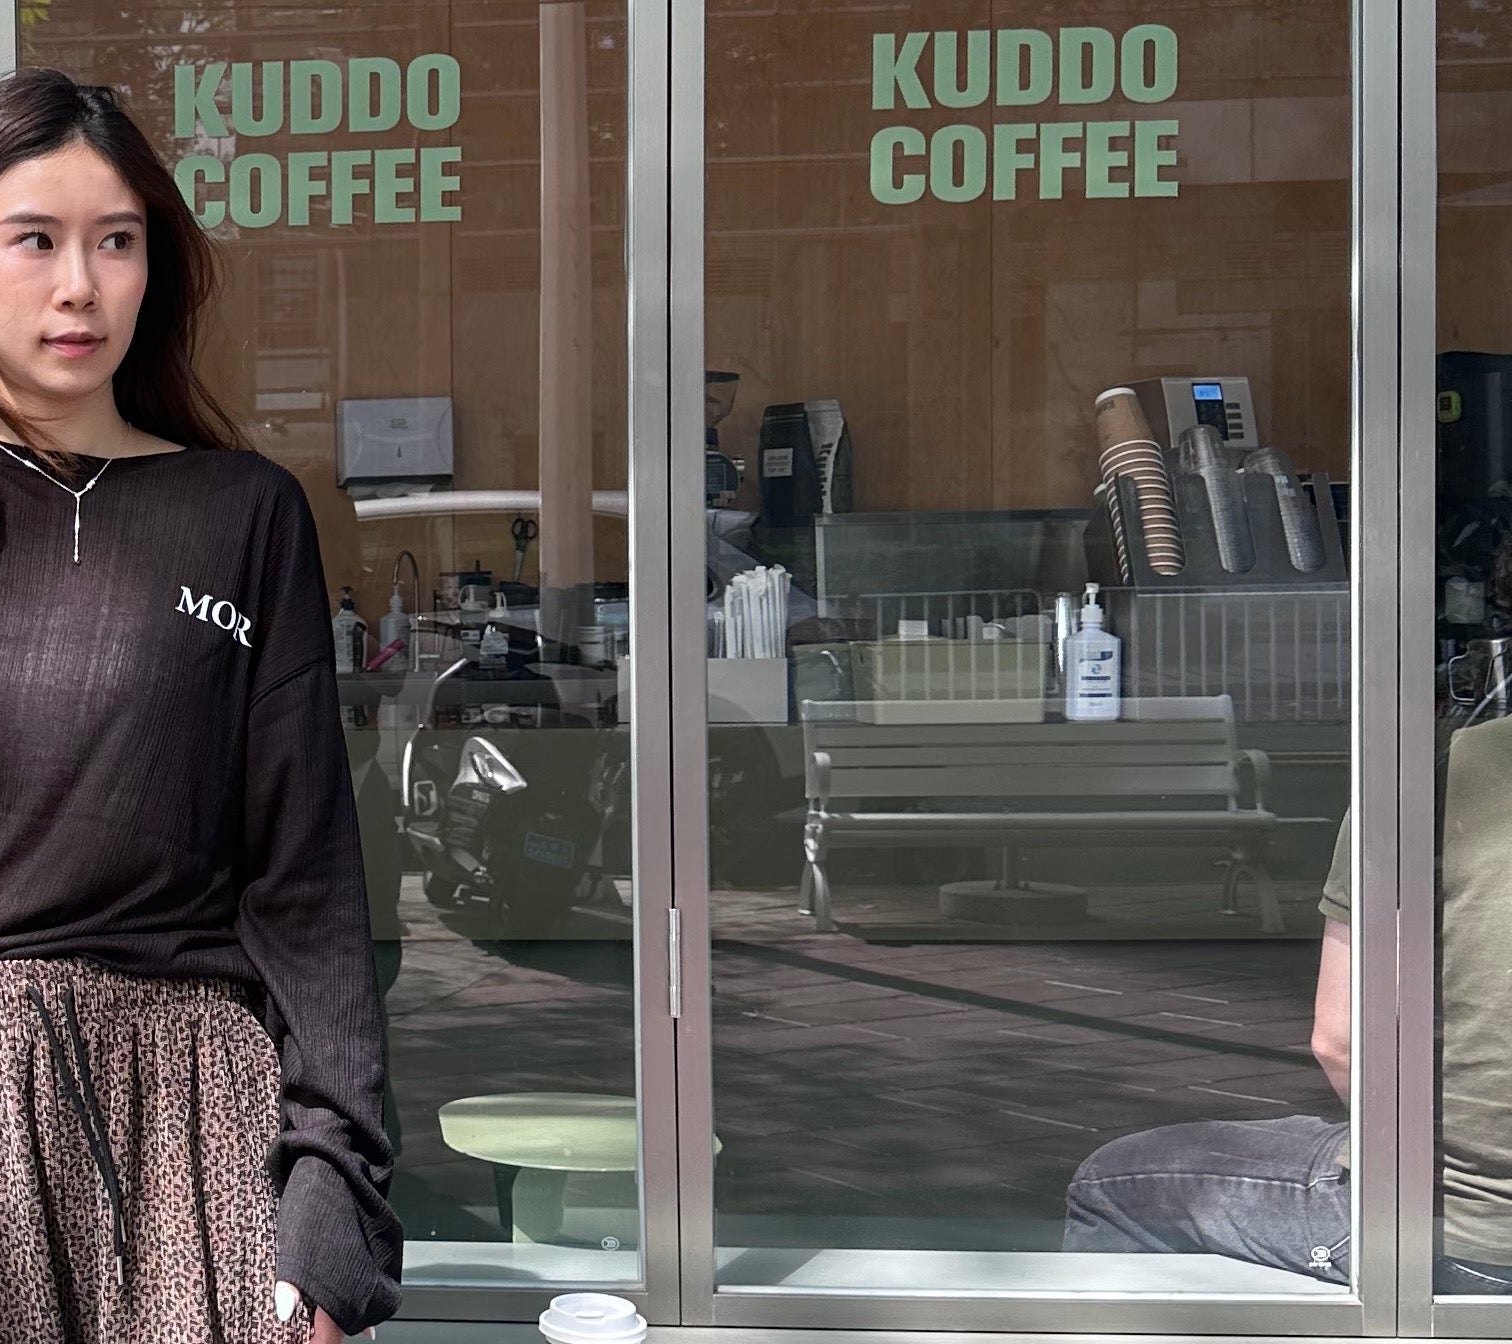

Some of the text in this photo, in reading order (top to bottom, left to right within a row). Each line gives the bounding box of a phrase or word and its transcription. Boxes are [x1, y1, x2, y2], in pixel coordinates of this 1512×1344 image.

[174, 53, 461, 138] KUDDO
[872, 24, 1178, 110] KUDDO
[174, 146, 463, 229] COFFEE
[869, 120, 1179, 205] COFFEE
[174, 585, 253, 648] MOR
